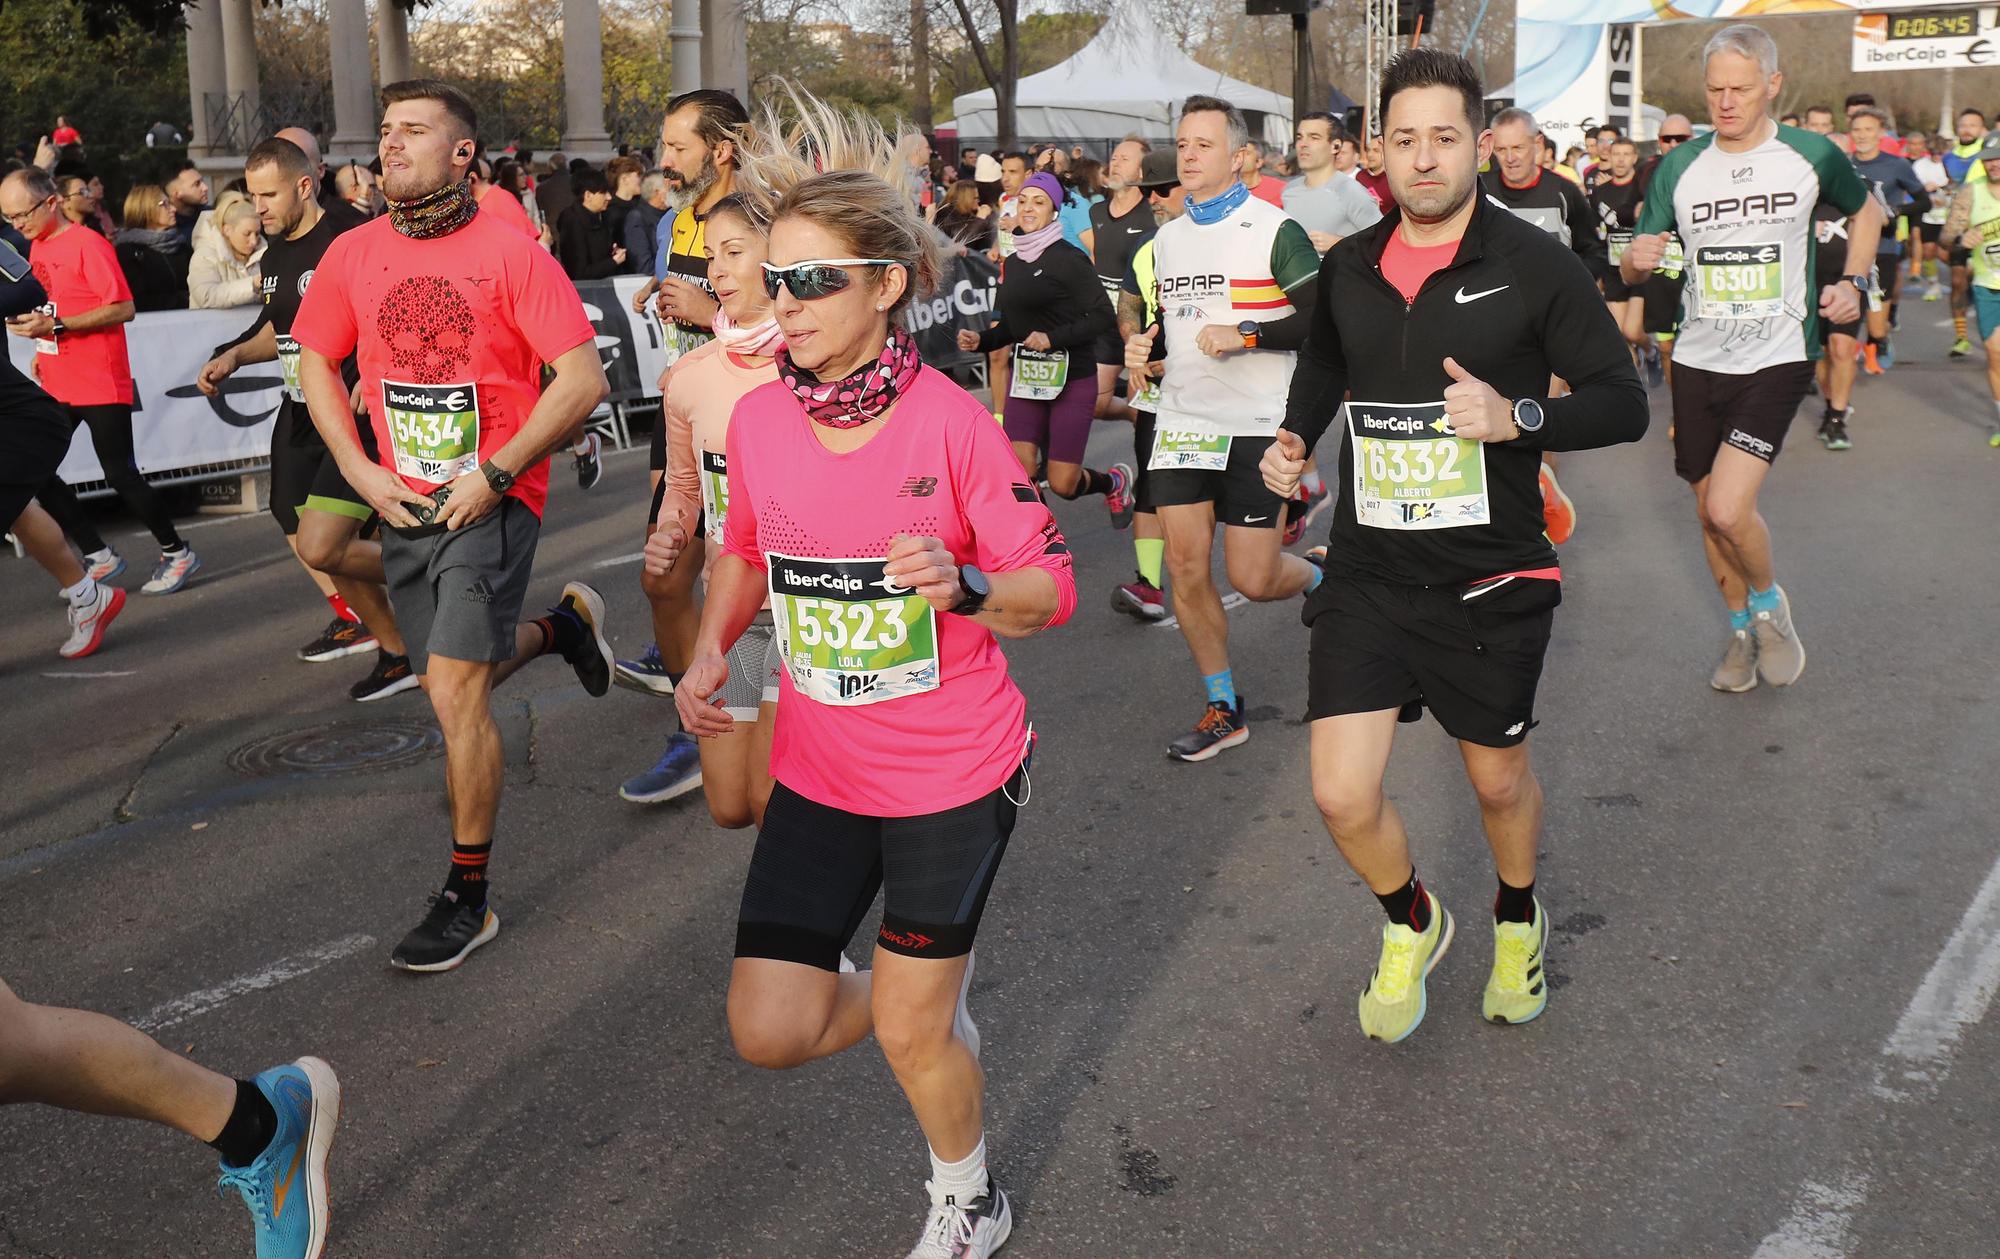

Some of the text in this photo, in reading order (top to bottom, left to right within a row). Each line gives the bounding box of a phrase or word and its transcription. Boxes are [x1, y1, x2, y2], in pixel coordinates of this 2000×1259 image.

[1893, 15, 1971, 37] 0:06:45
[1866, 46, 1947, 62] iberCaja
[1692, 192, 1798, 224] DPAP
[1706, 221, 1743, 233] PUENTE
[1759, 216, 1797, 226] PUENTE
[1703, 250, 1749, 262] iberCaja
[1163, 274, 1226, 293] DPAP
[1711, 266, 1768, 292] 6301
[905, 276, 998, 334] iberCaj
[1022, 359, 1059, 381] 5357
[389, 390, 434, 409] iberCaja
[394, 411, 464, 447] 5434
[1363, 414, 1424, 435] iberCaja
[1369, 440, 1463, 484] 6332
[1394, 487, 1432, 498] ALBERTO
[784, 568, 863, 595] iberCaja
[795, 598, 908, 650] 5323
[837, 655, 864, 668] LOLA
[807, 668, 812, 679] 6
[837, 673, 880, 699] 10K
